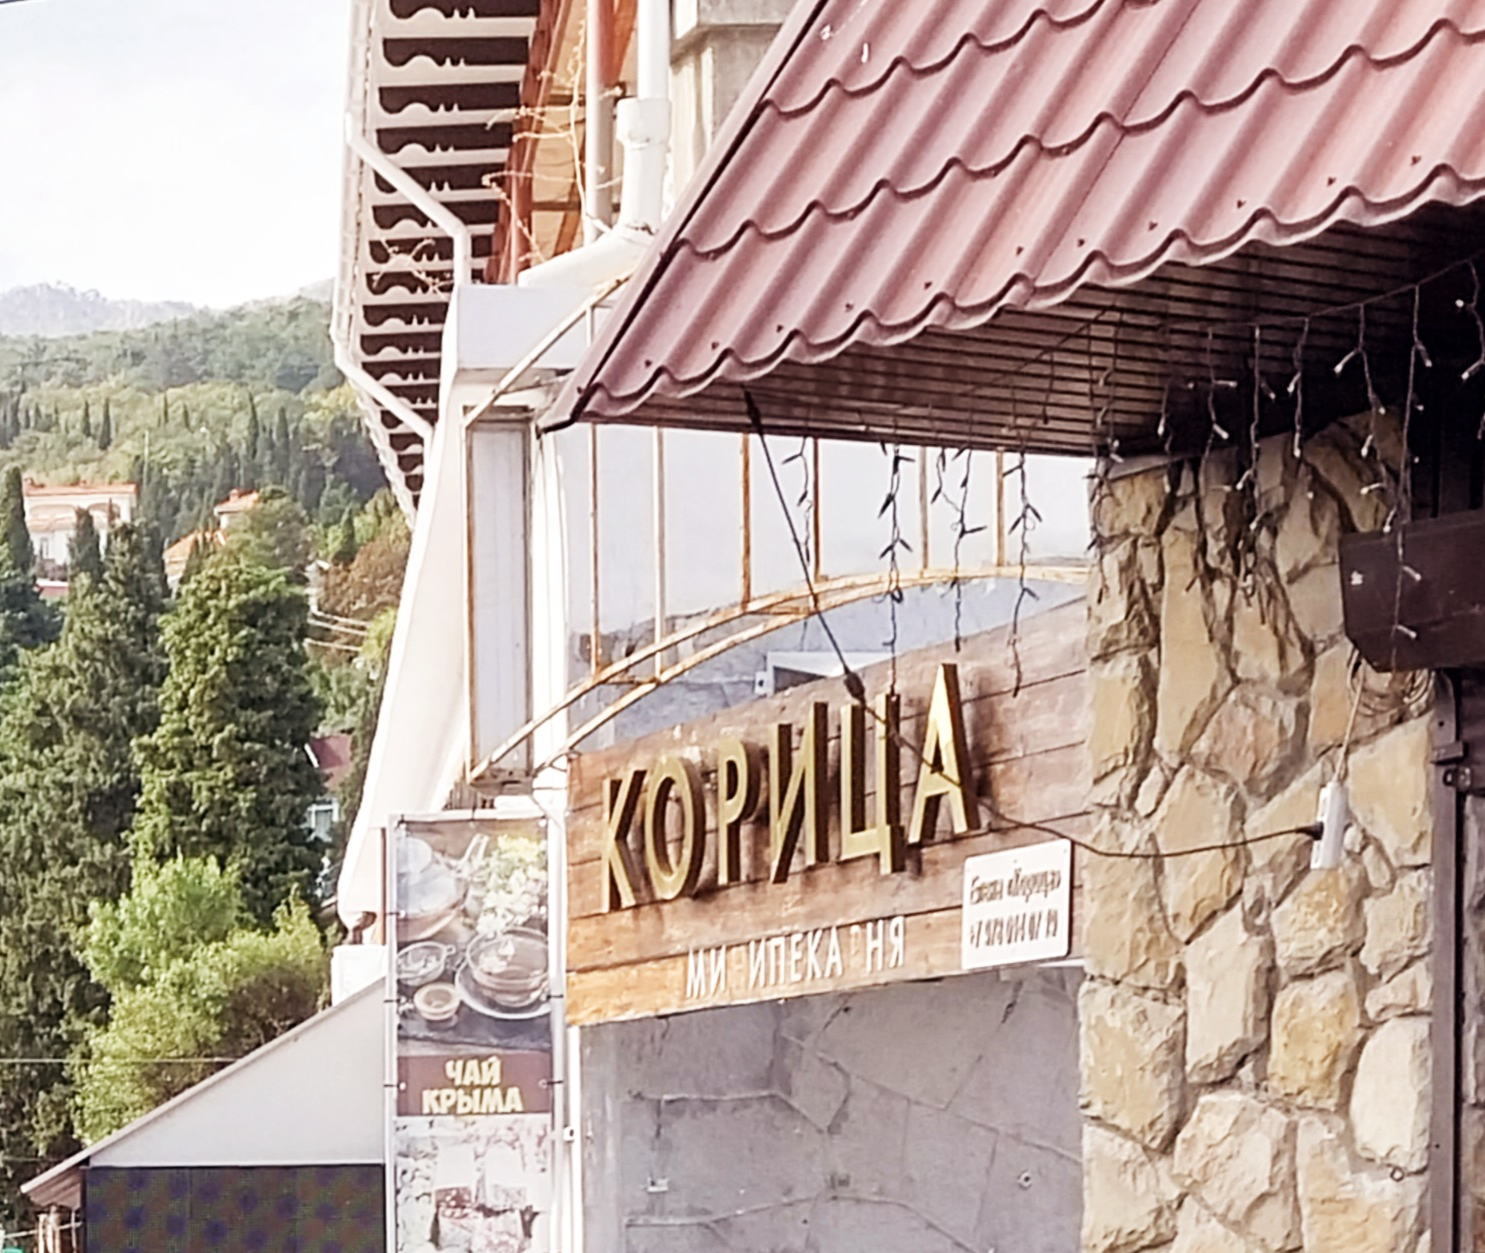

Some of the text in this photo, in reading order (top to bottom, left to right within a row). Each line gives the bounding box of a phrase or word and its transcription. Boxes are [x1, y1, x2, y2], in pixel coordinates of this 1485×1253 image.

[602, 663, 979, 914] КОРИЦА
[445, 1055, 501, 1087] ЧАЙ
[422, 1086, 523, 1114] КРЫМА
